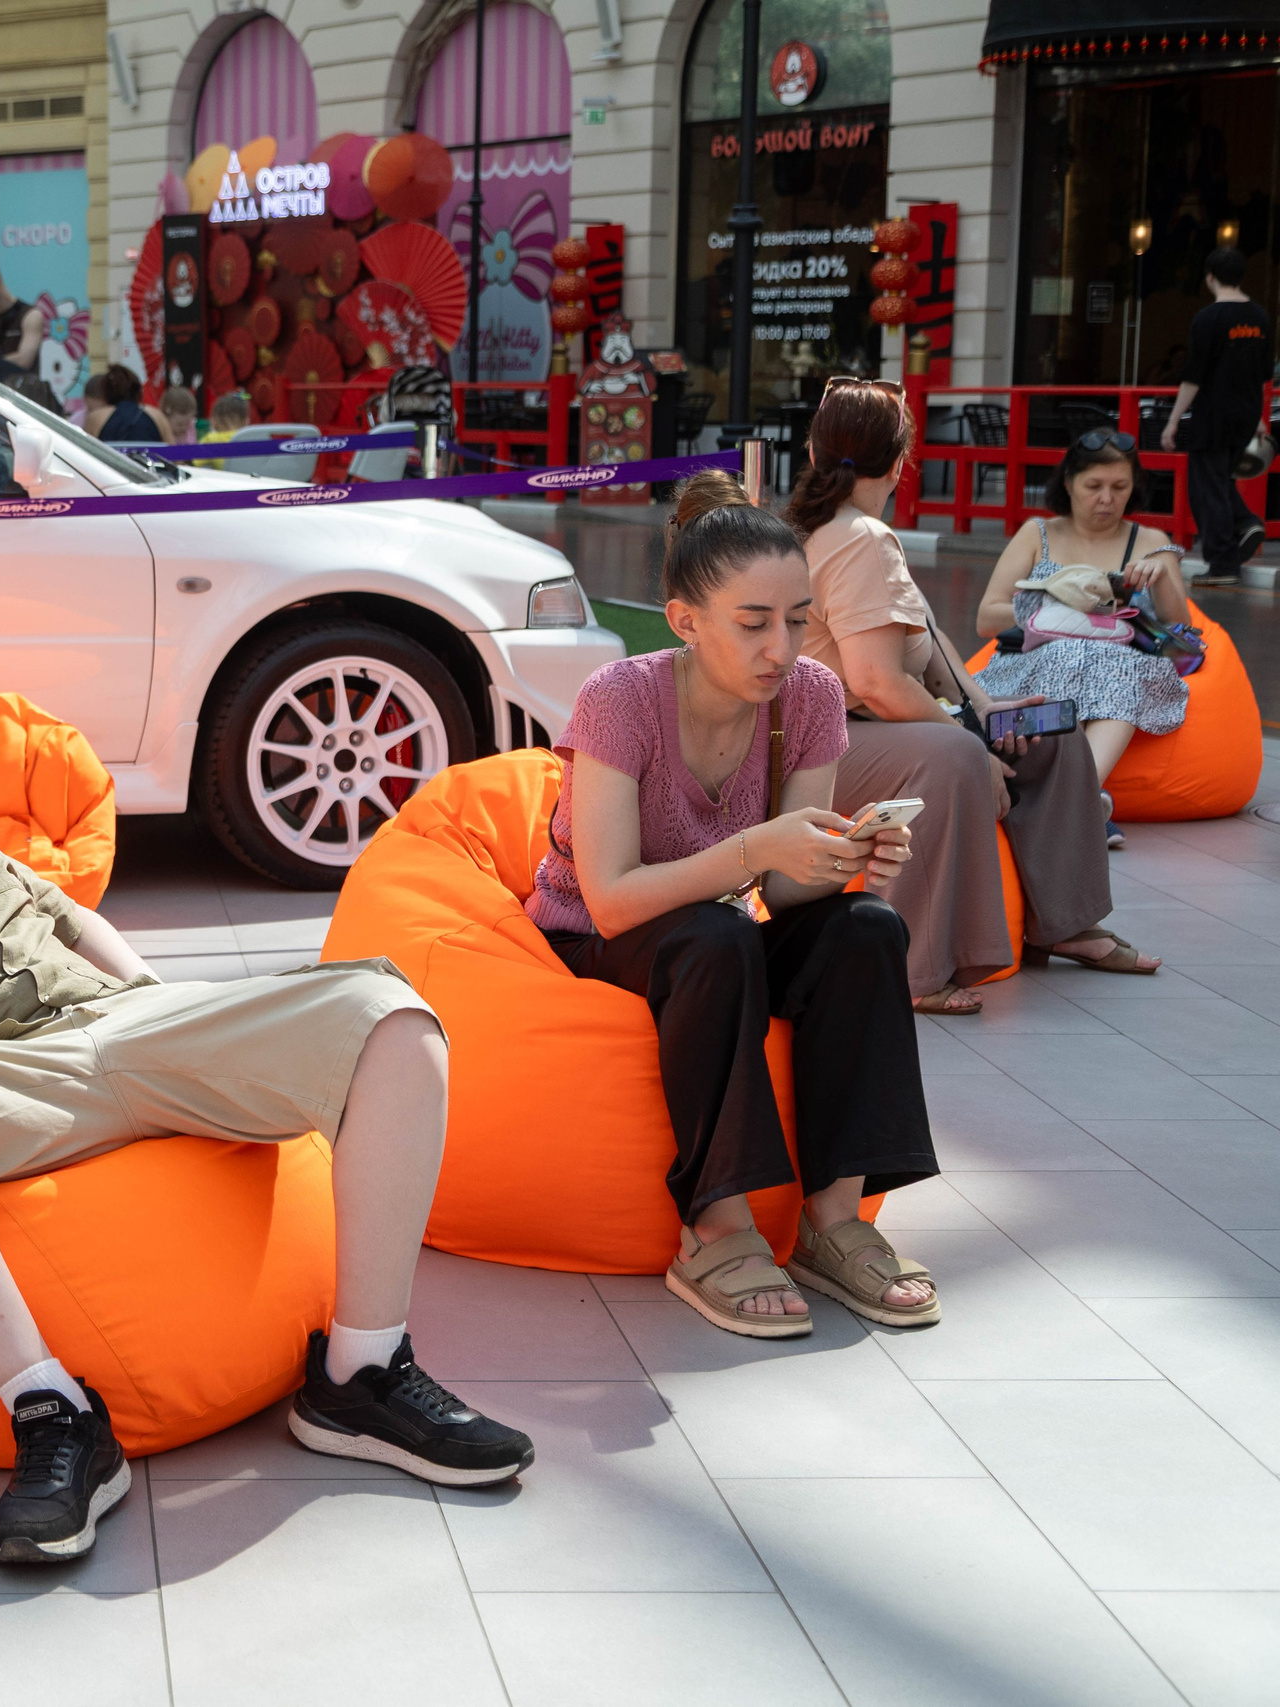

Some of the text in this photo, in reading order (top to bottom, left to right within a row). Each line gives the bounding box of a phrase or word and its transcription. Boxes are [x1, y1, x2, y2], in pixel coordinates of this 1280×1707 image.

[256, 162, 330, 194] ОСТРОВ
[261, 189, 325, 219] МЕЧТЫ
[1, 221, 71, 248] СКОРО
[752, 255, 848, 283] кидка 20%
[802, 325, 831, 340] 17:00
[541, 471, 608, 484] ШИКАНА
[271, 491, 341, 501] ШИКАНА
